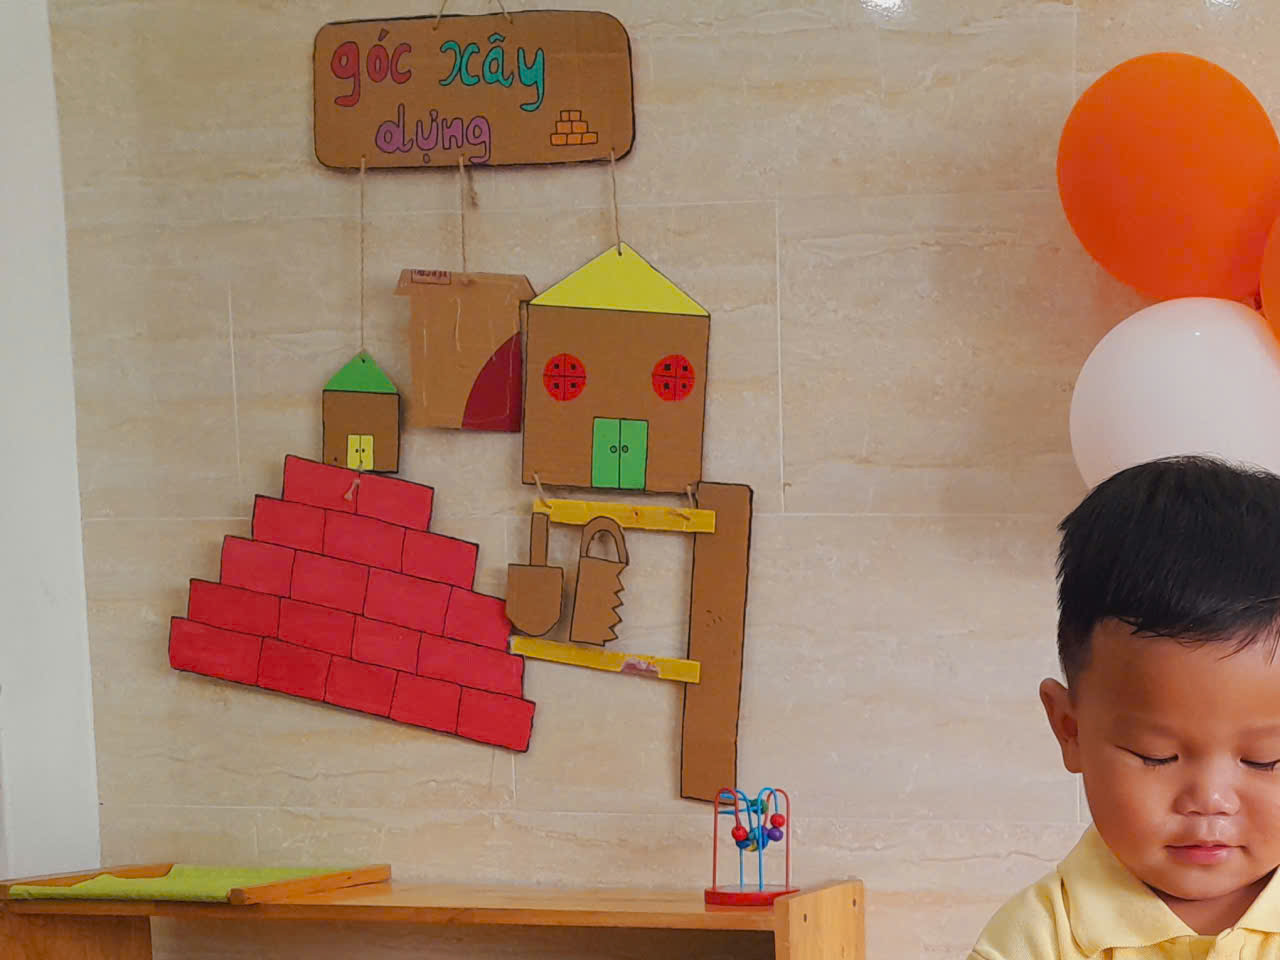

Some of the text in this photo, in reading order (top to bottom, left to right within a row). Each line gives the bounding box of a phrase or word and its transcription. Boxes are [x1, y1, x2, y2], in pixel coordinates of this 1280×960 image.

[330, 28, 546, 112] góc xây
[375, 103, 491, 164] dựng
